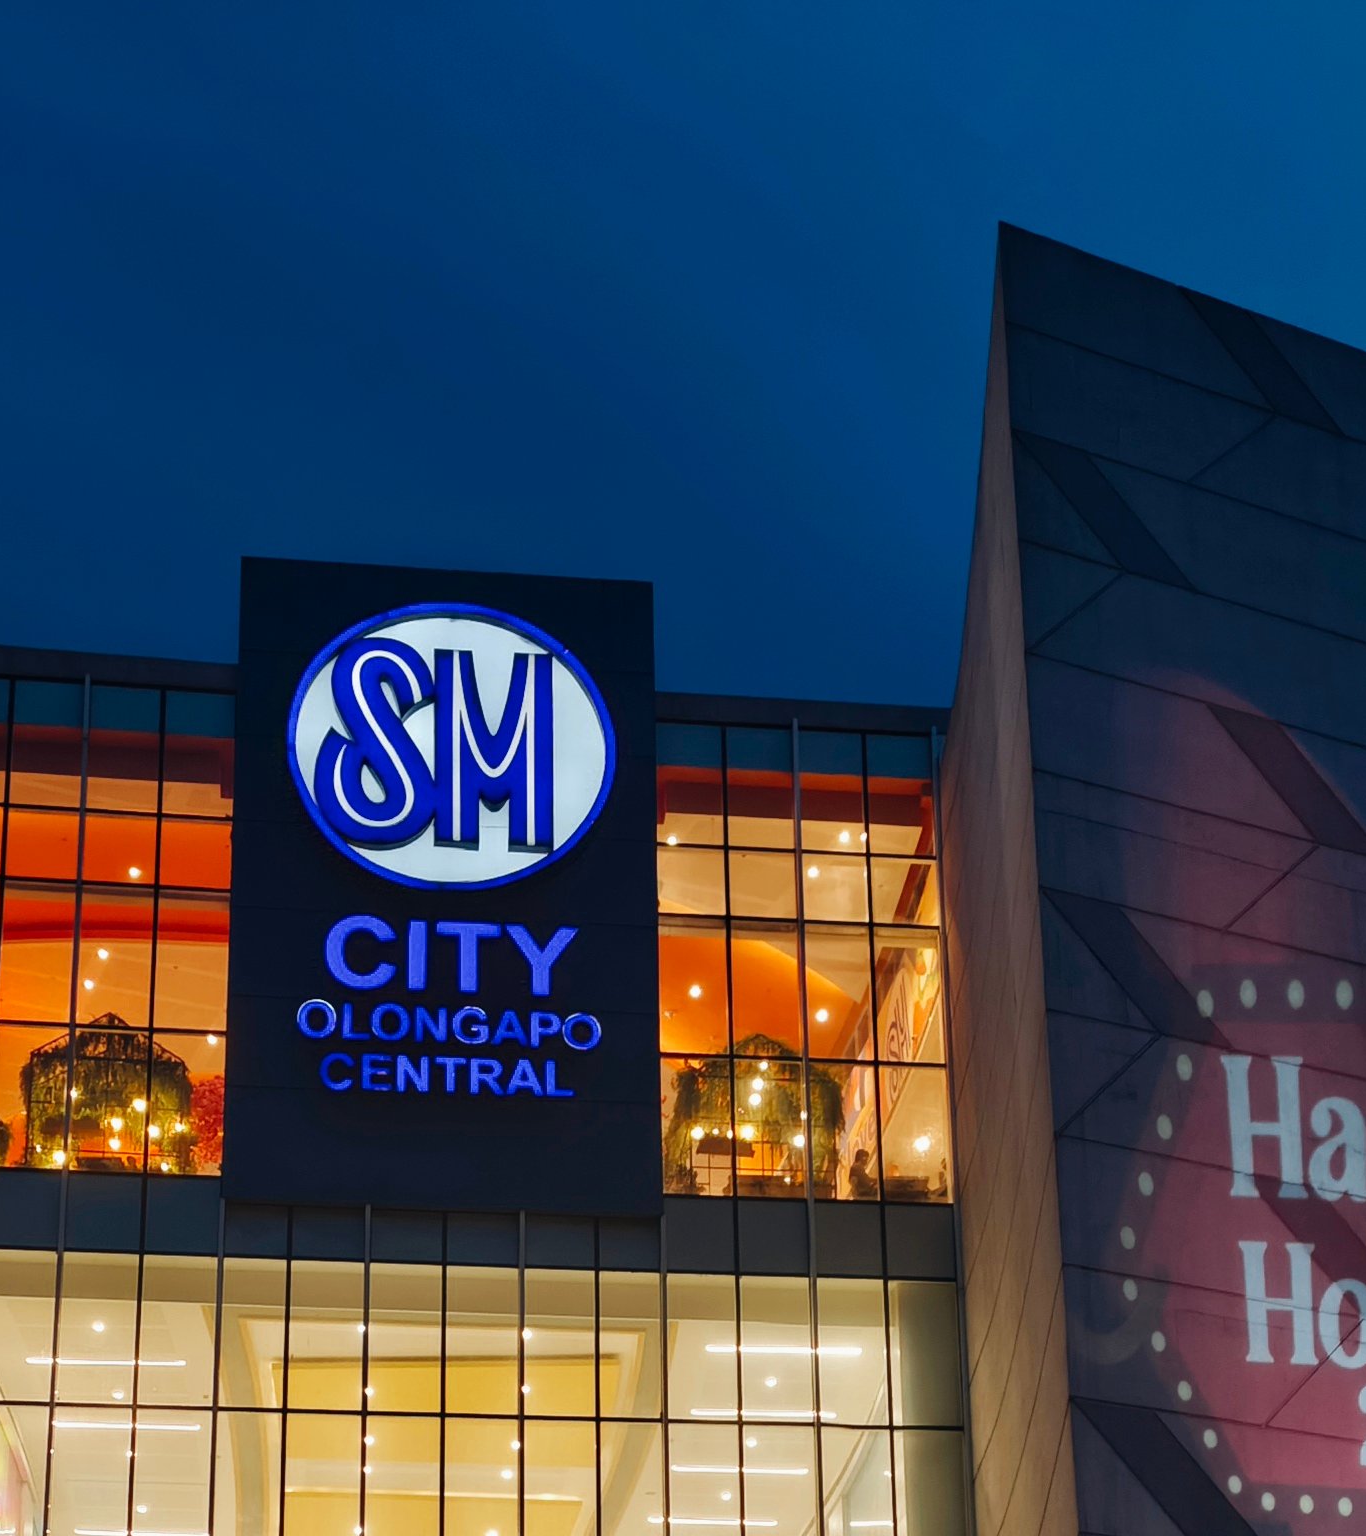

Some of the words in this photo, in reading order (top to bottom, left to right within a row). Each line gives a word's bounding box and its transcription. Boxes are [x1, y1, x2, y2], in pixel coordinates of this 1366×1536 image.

[314, 637, 553, 853] SM
[325, 915, 579, 996] CITY
[296, 998, 602, 1051] OLONGAPO
[320, 1053, 574, 1097] CENTRAL
